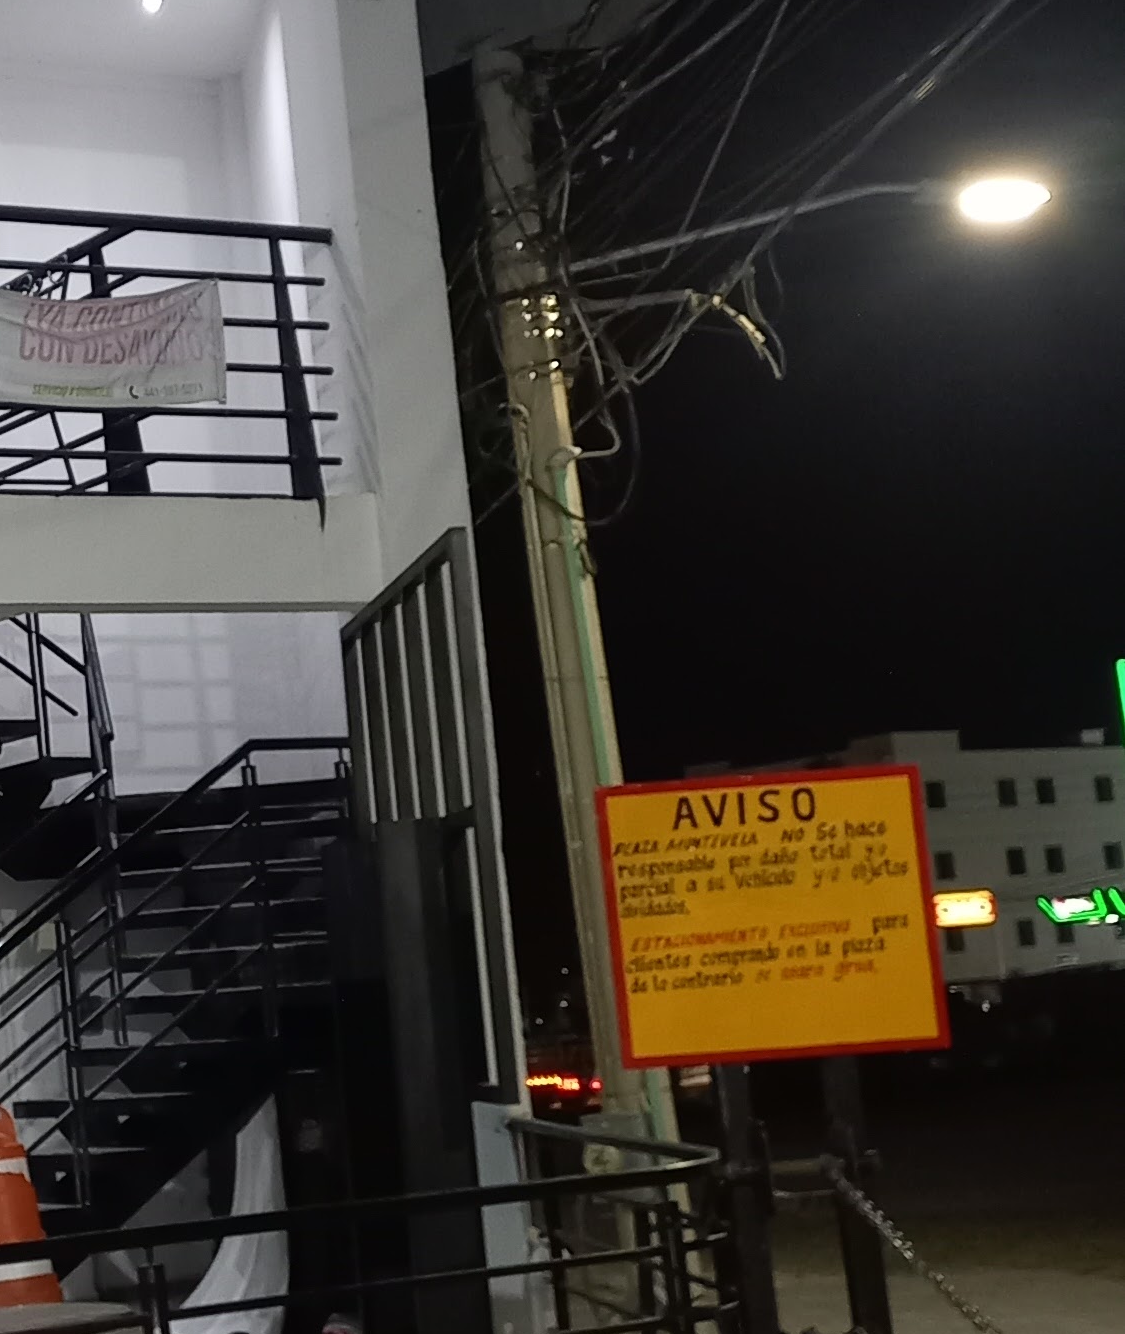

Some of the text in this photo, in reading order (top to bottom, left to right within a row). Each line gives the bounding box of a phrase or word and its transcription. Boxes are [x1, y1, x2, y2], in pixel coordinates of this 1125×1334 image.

[20, 326, 74, 364] CON
[672, 788, 815, 831] AVISO
[614, 840, 658, 856] PLAZA
[781, 828, 805, 843] NO
